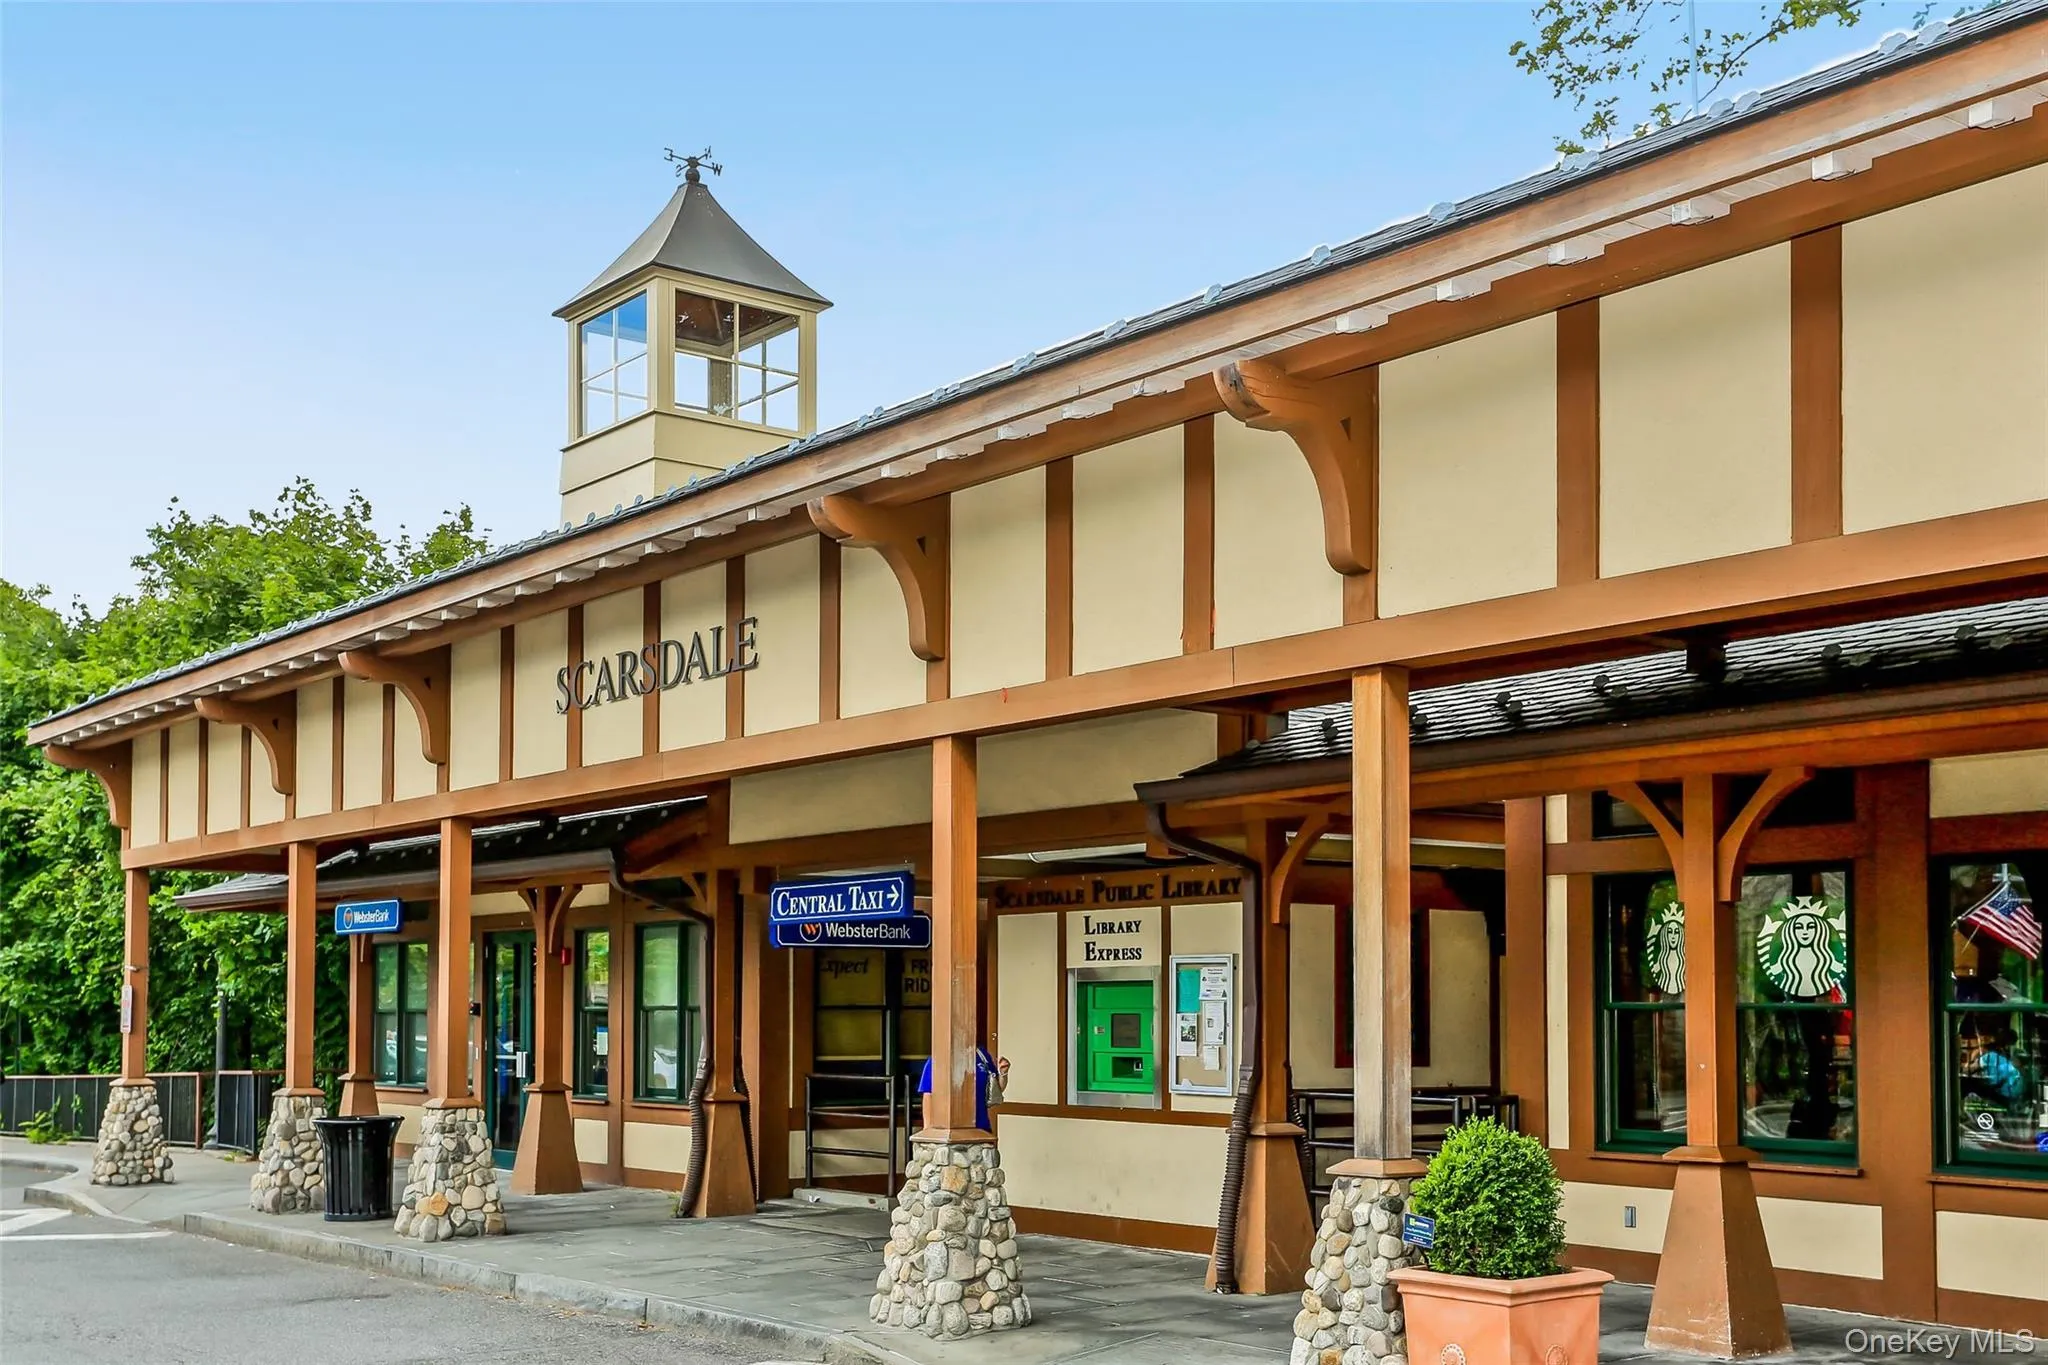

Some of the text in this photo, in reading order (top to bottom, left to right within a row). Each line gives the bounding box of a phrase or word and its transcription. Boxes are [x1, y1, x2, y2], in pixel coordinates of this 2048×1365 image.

[556, 616, 760, 714] SCARSDALE
[777, 885, 884, 916] CENTRAL TAXI
[994, 874, 1243, 909] SCARSDALE PUBLIC LIBRARY
[825, 922, 911, 940] WebsterBank
[1084, 916, 1142, 936] LIBRARY
[1084, 941, 1142, 962] EXPRESS
